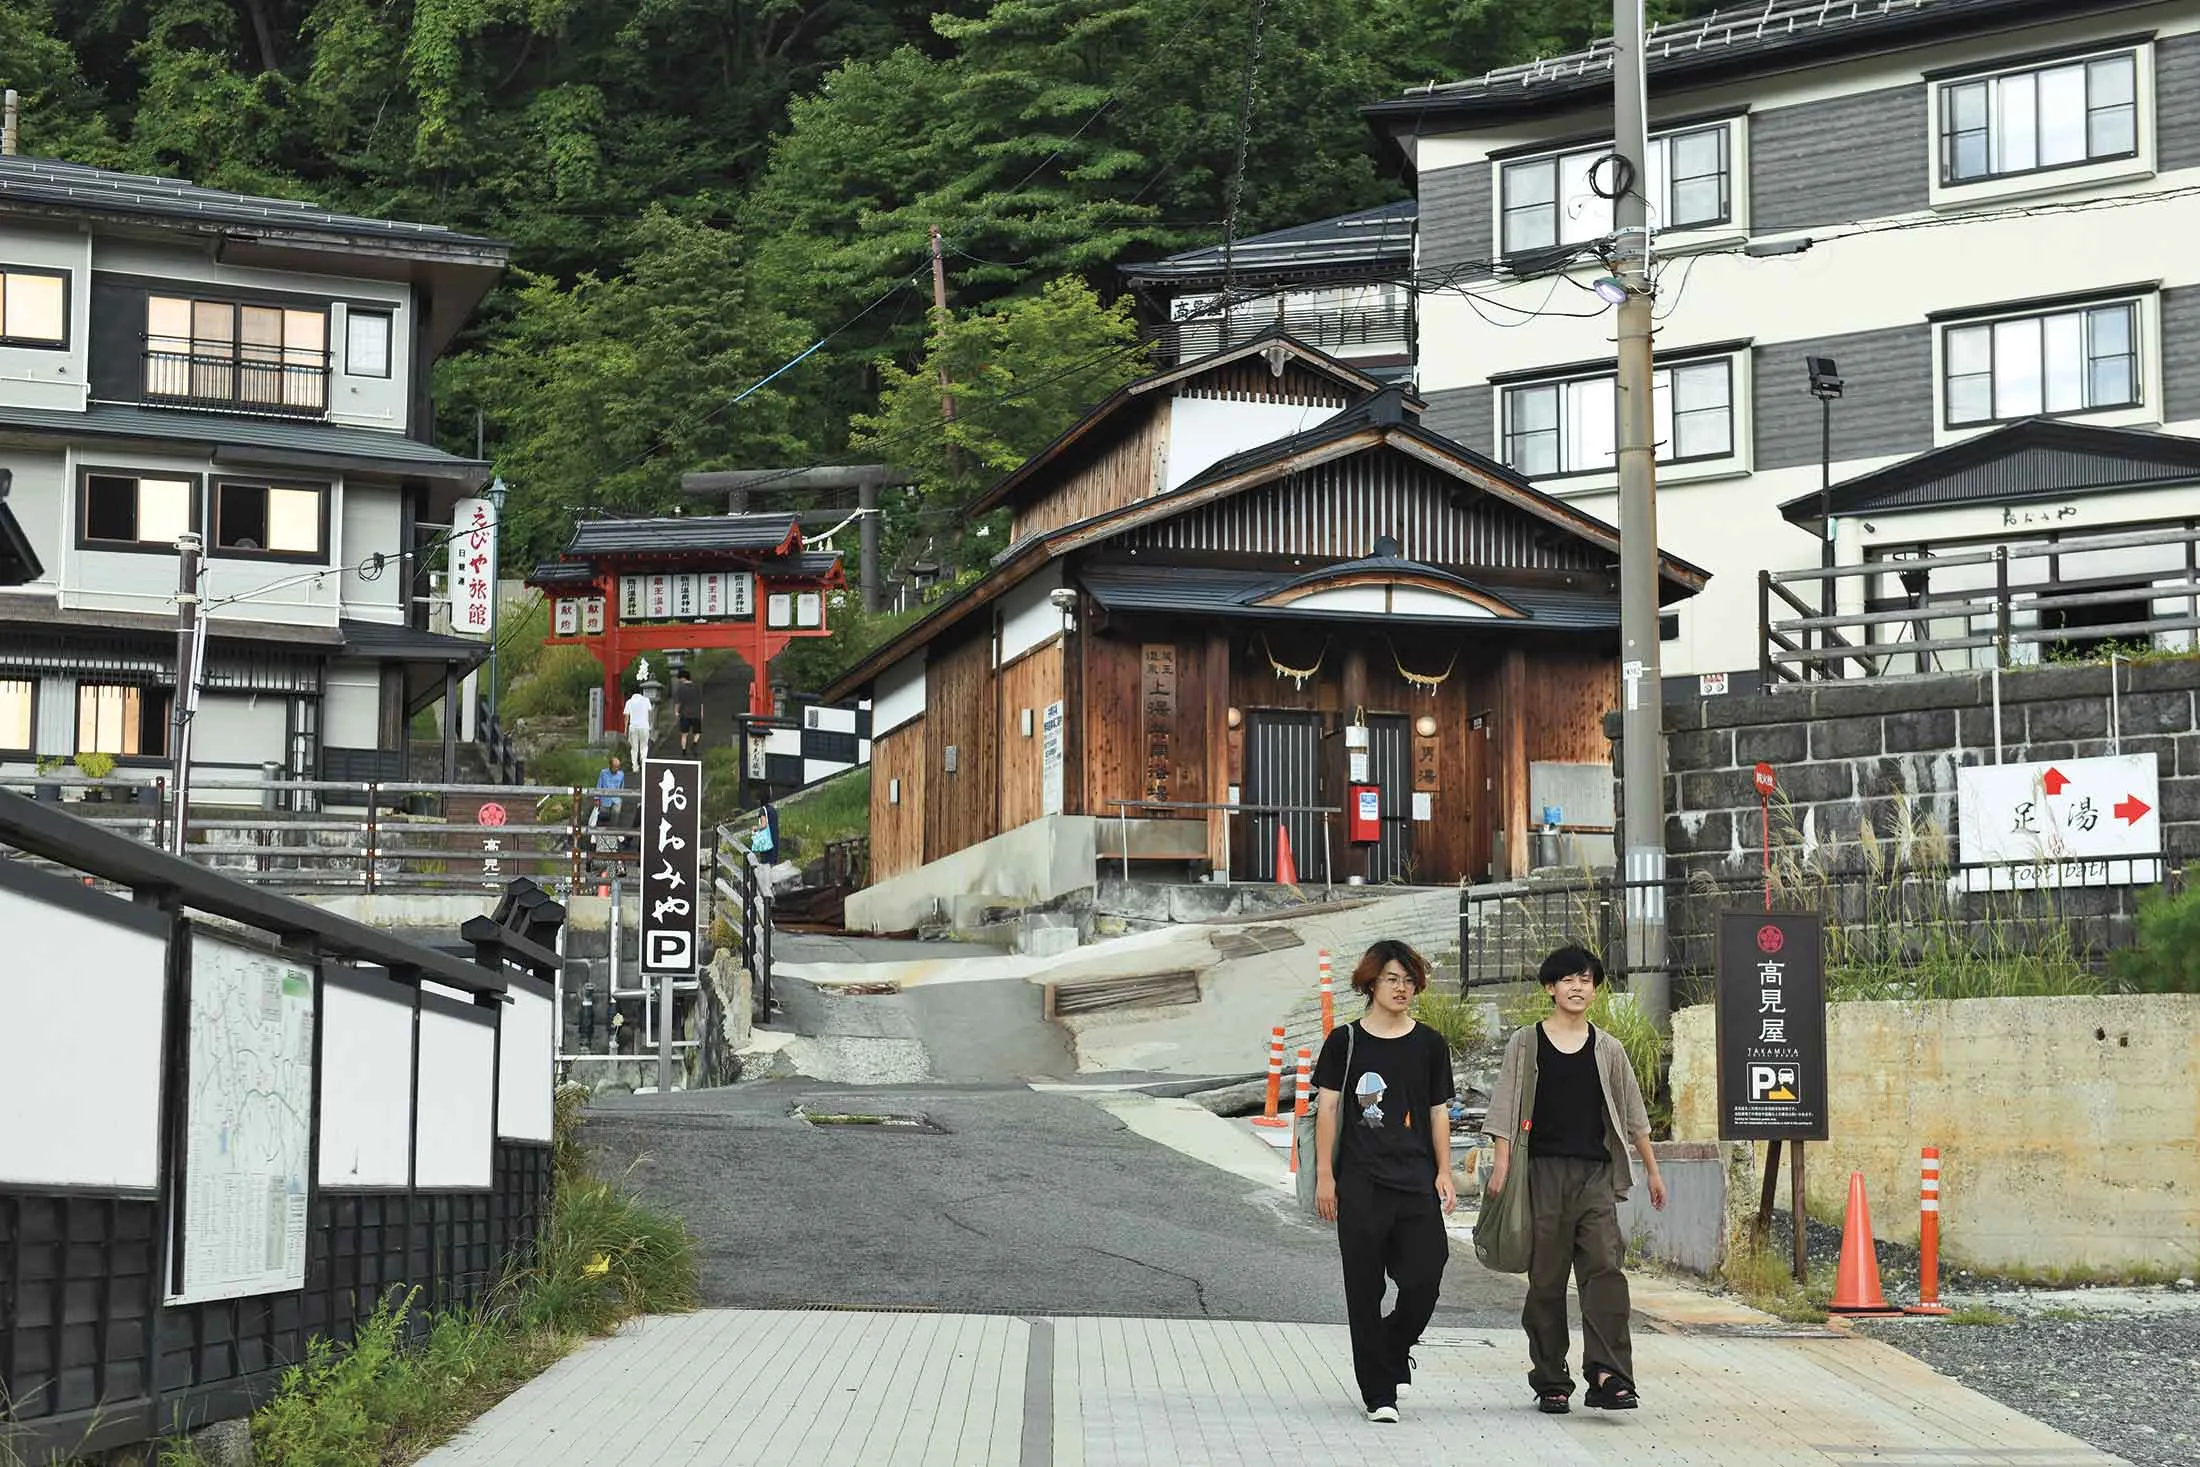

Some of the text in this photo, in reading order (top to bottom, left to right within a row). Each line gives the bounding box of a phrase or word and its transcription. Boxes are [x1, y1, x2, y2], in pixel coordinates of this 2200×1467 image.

[468, 506, 490, 625] えびや旅館
[2012, 797, 2098, 834] 足湯
[652, 769, 690, 924] おおみや
[653, 935, 686, 964] P
[1757, 960, 1787, 1043] 高見屋
[1747, 1047, 1800, 1055] TAKAMIYA
[1752, 1067, 1776, 1100] P
